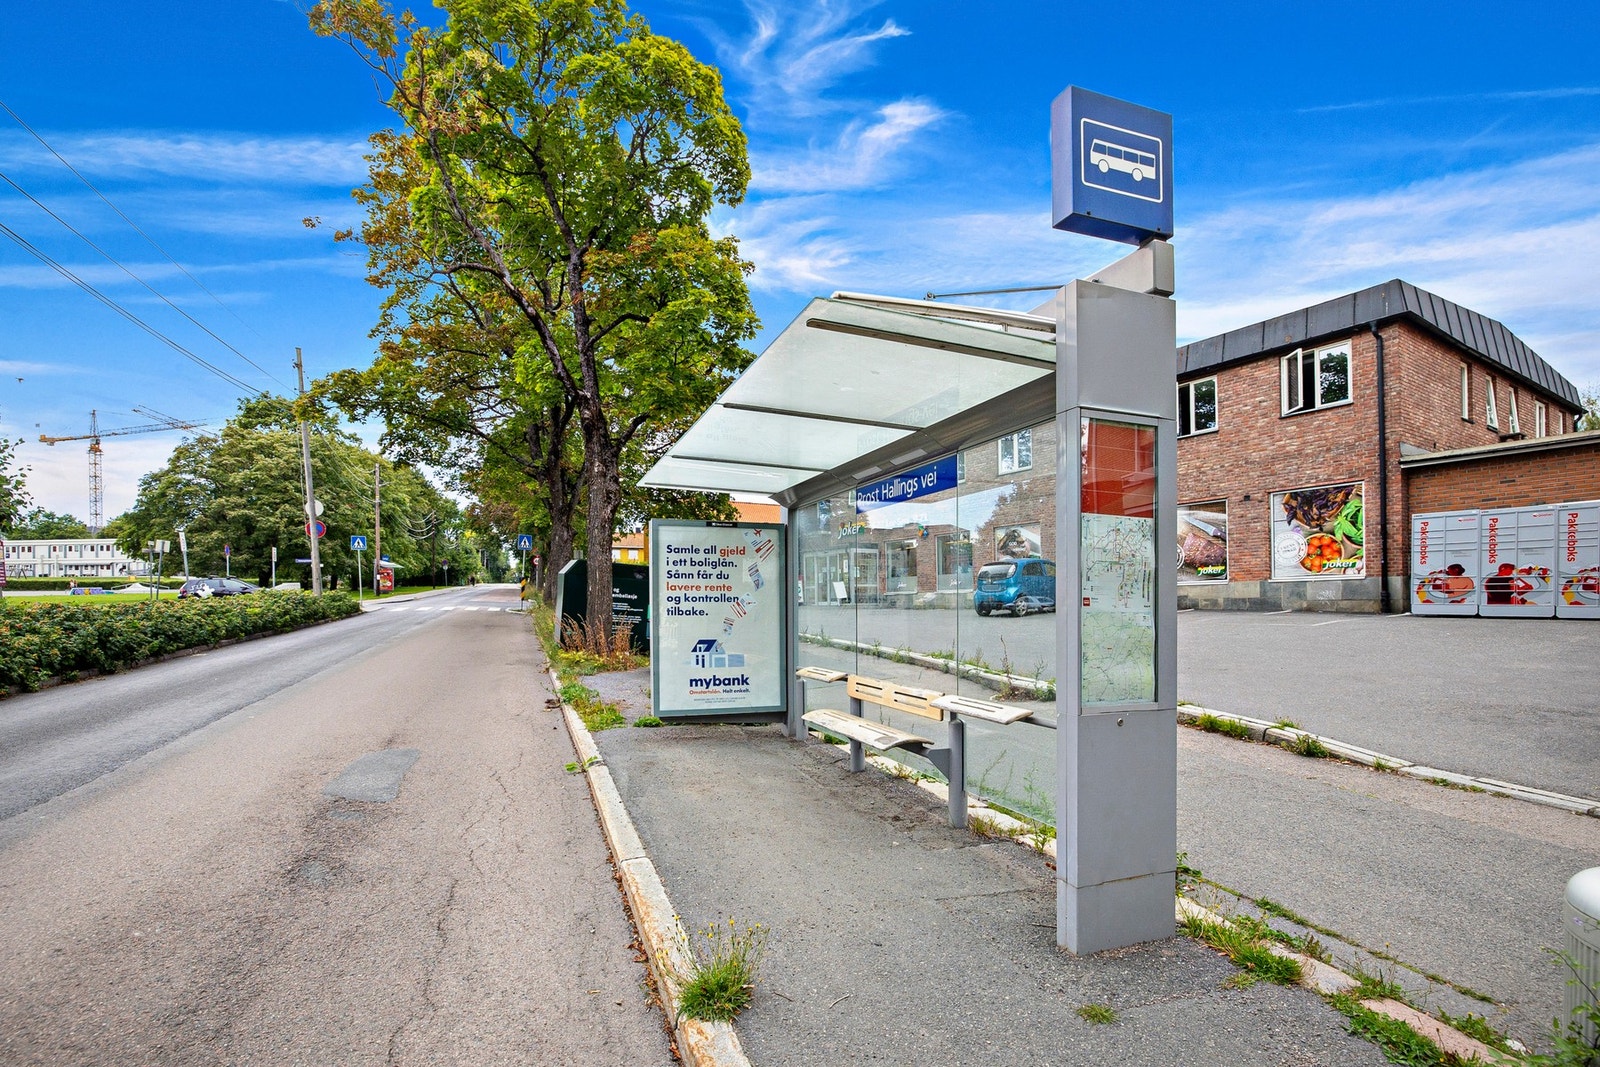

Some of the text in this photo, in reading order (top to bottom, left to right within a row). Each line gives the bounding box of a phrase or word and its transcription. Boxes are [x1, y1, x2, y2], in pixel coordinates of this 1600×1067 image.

[857, 466, 937, 503] Prost Hallings vei
[666, 544, 746, 558] Samle all gjeld
[666, 556, 738, 570] i ett boliglån.
[666, 569, 730, 580] Sånn får du
[666, 581, 733, 592] lavere rente
[666, 593, 739, 605] og kontrollen
[666, 606, 709, 616] tilbake.
[689, 674, 750, 689] mybank
